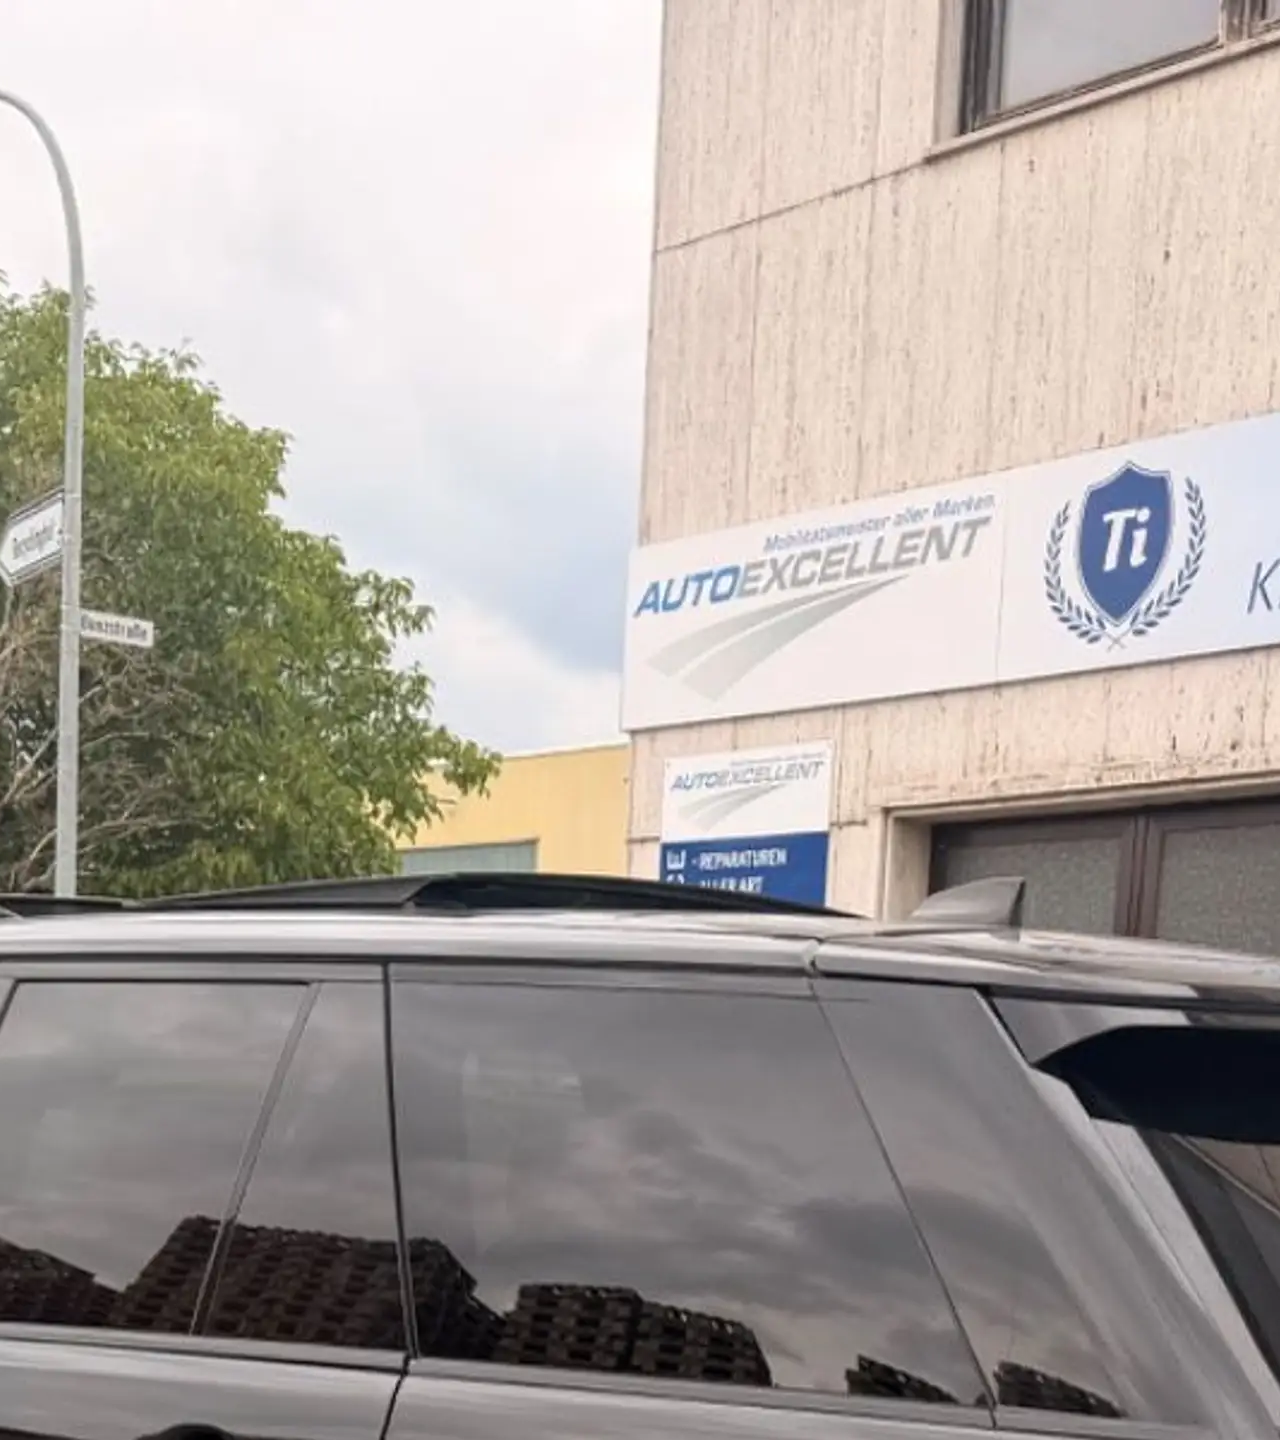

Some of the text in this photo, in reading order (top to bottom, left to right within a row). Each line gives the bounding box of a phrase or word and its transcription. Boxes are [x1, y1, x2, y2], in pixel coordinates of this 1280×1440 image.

[932, 494, 996, 519] Marken
[1102, 507, 1152, 572] Ti
[632, 516, 992, 618] AUTOEXCELLENT
[670, 760, 824, 791] AUTOEXCELLENT
